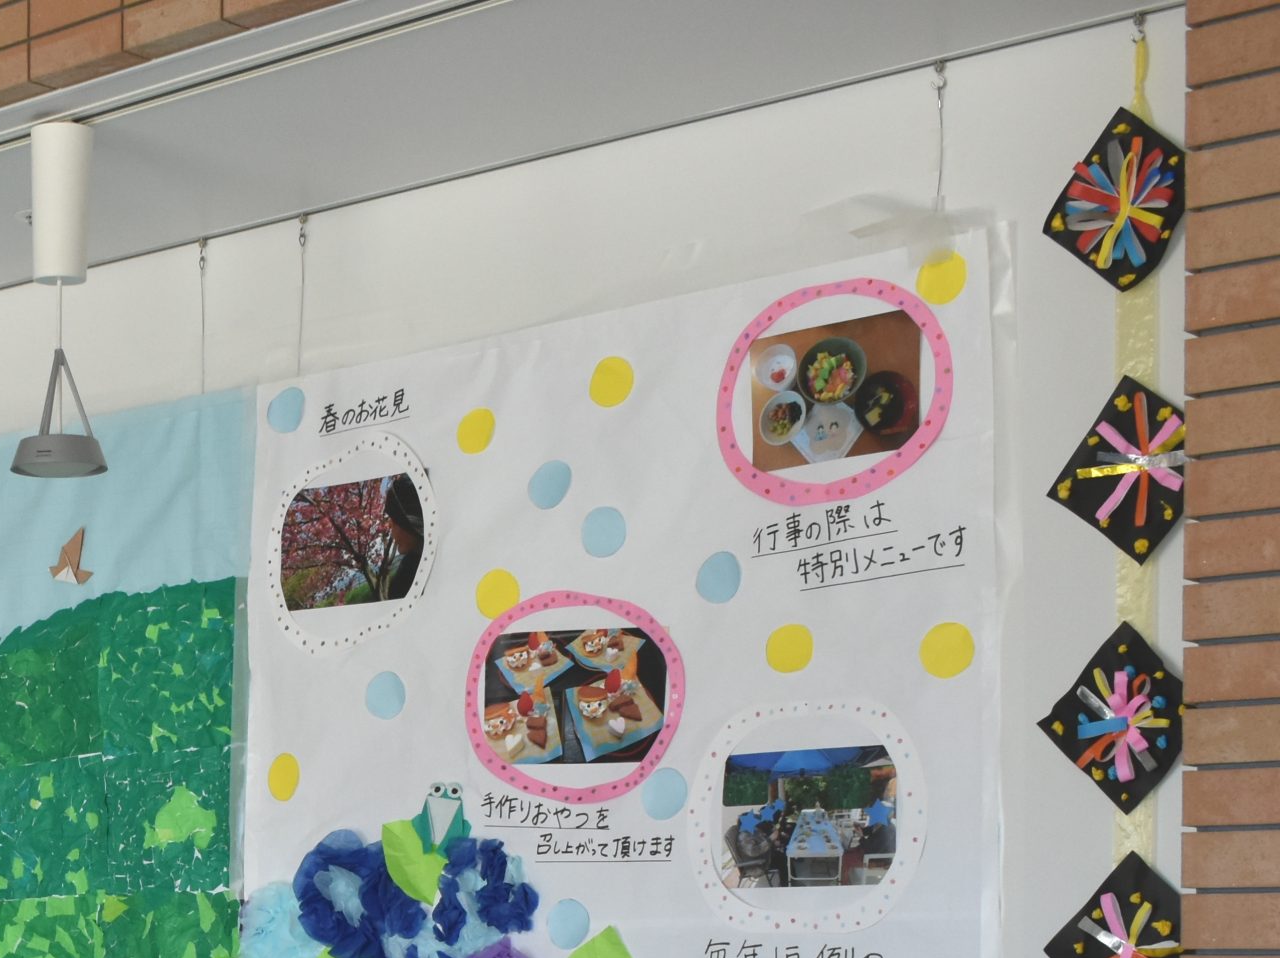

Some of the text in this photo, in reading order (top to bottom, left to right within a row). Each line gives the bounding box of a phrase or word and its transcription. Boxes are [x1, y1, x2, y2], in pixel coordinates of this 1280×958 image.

[319, 388, 409, 433] 春のお花見
[752, 500, 892, 553] 行事の際は
[797, 525, 967, 584] 特別メニューです
[480, 791, 610, 830] 手作りおやつを
[536, 833, 675, 858] 召し上がって頂けます
